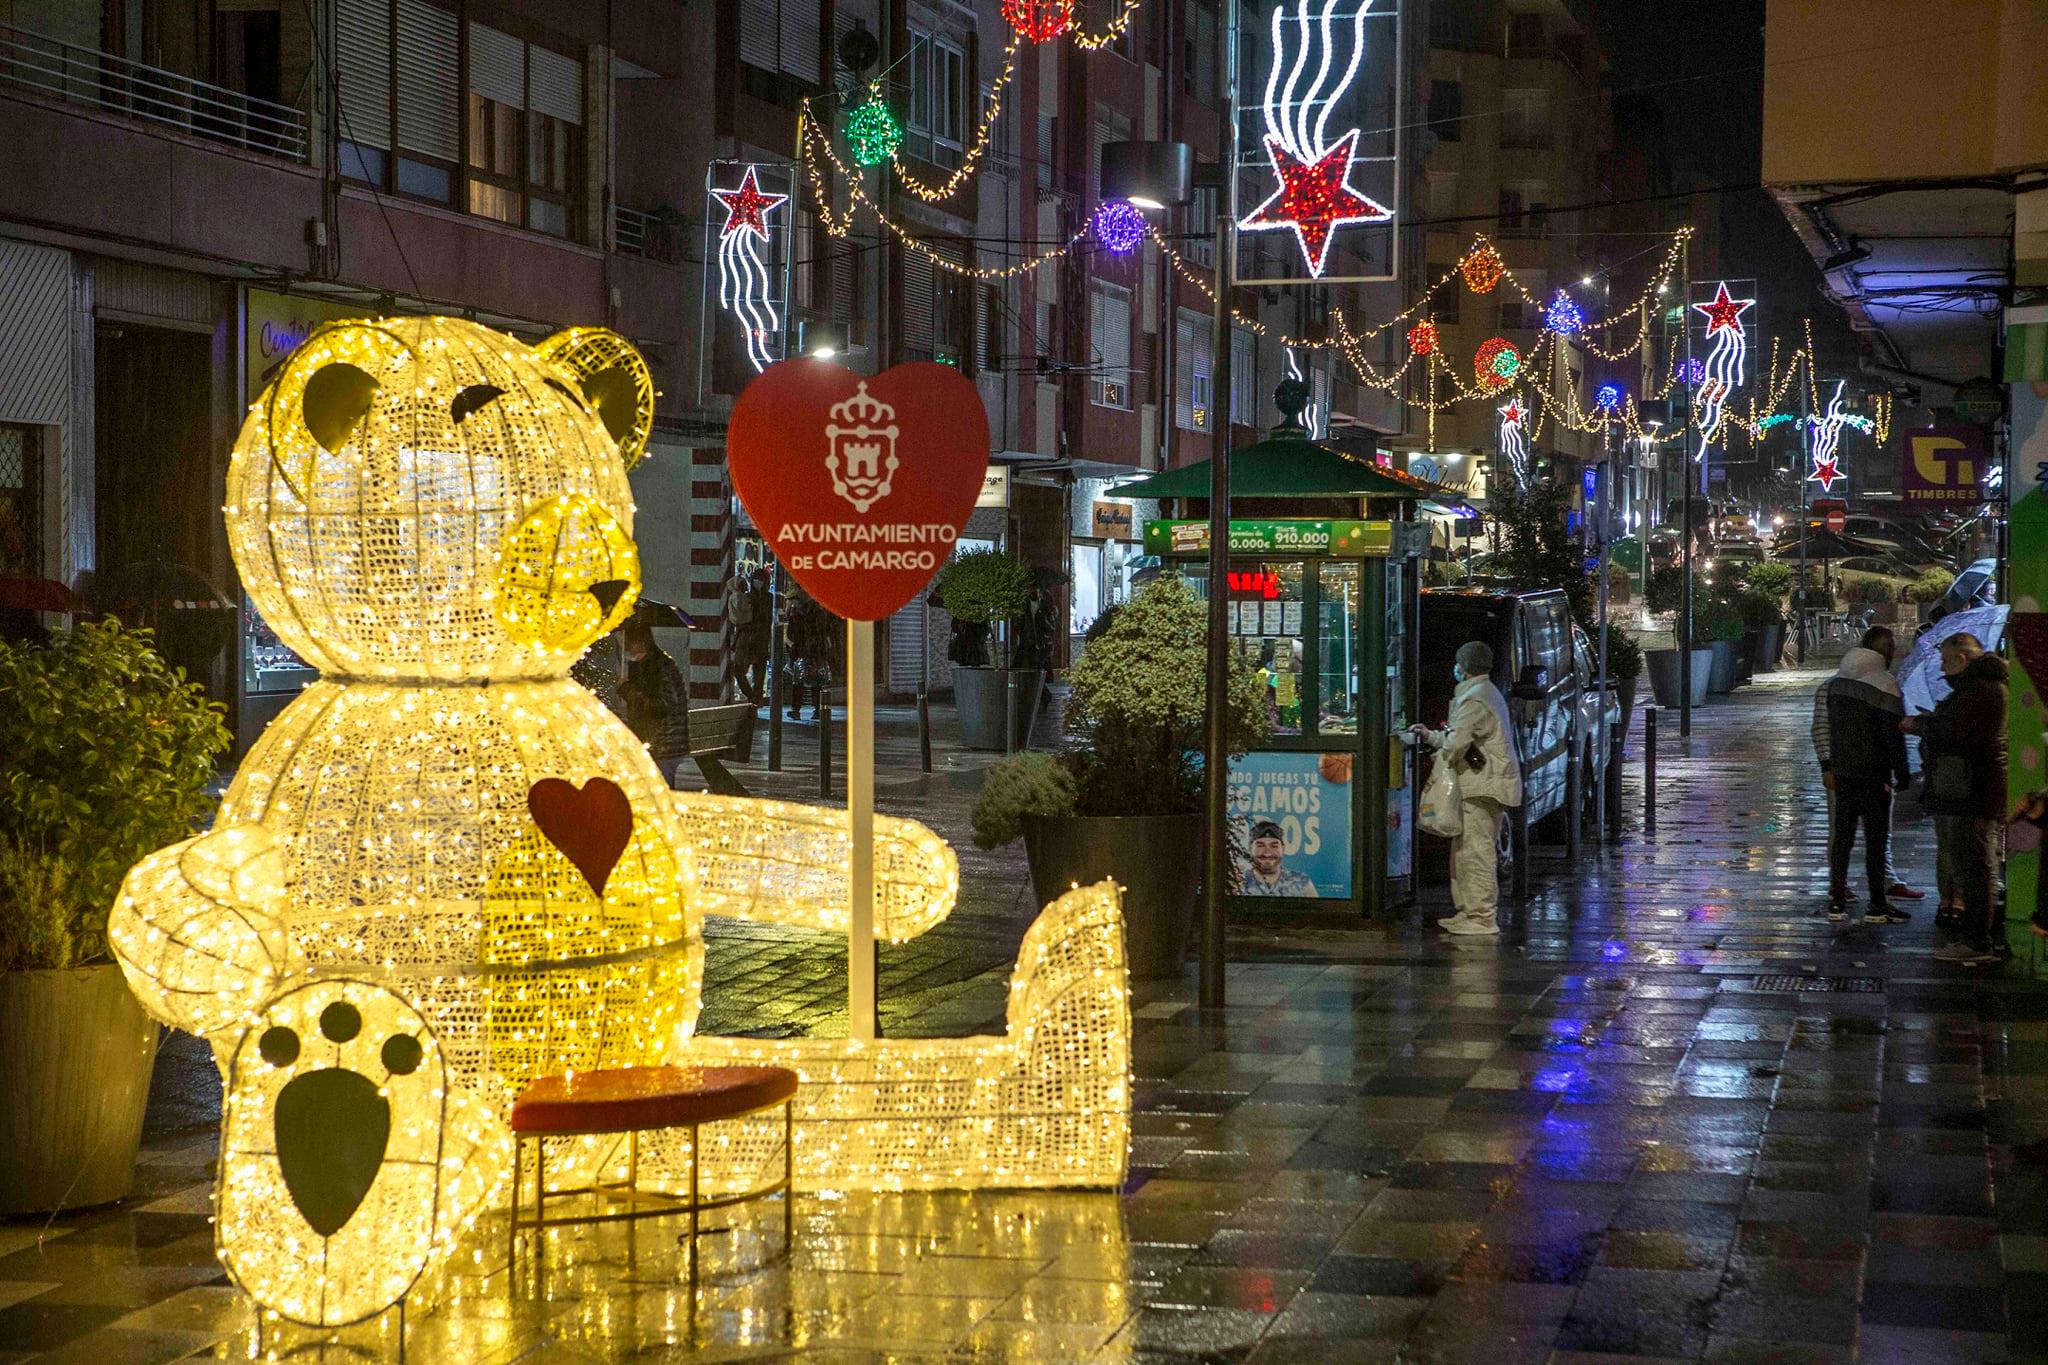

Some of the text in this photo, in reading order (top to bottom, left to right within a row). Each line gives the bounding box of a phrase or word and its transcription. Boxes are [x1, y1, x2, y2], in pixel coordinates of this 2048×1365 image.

[1907, 489, 1978, 499] TIMBRES
[777, 524, 957, 543] AYUNTAMIENTO
[1275, 533, 1330, 544] 910.000
[791, 550, 935, 570] DE CAMARGO
[1258, 772, 1299, 784] JUEGAS
